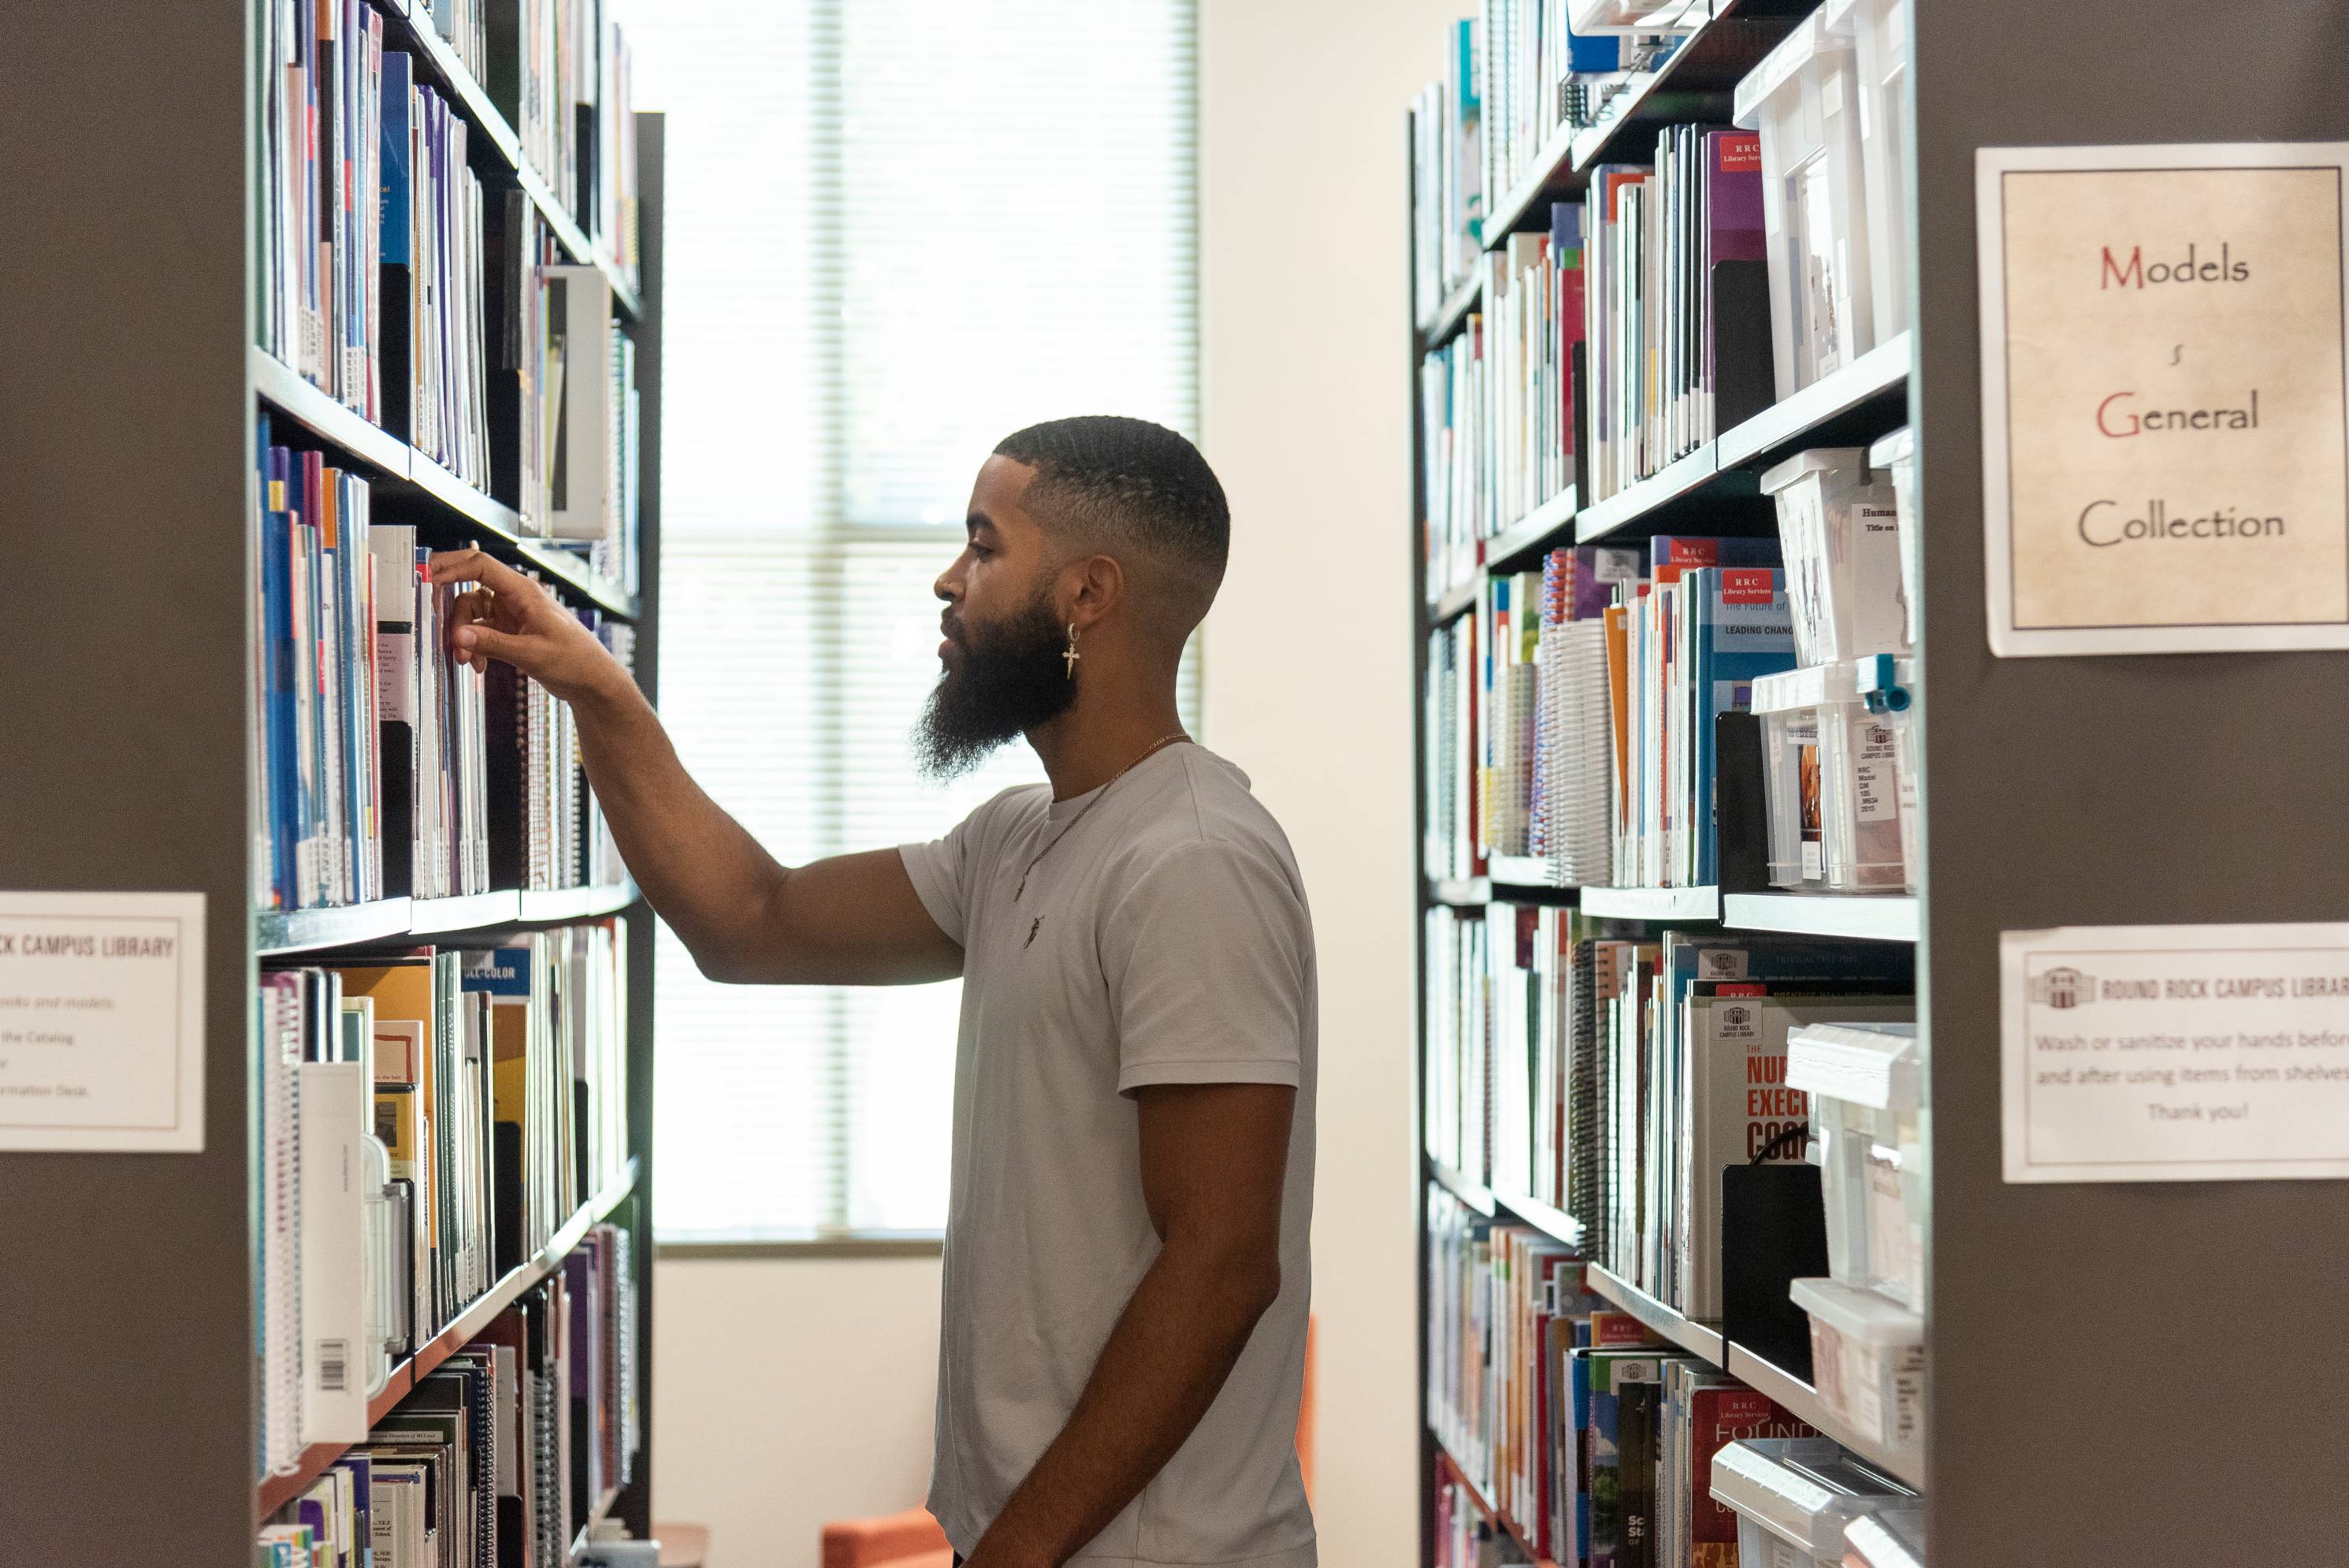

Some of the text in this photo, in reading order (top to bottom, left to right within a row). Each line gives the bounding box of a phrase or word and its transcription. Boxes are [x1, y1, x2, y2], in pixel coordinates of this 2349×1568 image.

[2101, 243, 2250, 290] Models
[2096, 391, 2258, 438] General
[1862, 508, 1897, 517] Human
[2078, 500, 2284, 548] Collection
[22, 935, 94, 957] CAMPUS
[102, 937, 173, 957] LIBRARY
[2102, 979, 2159, 1000] ROUND
[2165, 979, 2208, 998] ROCK
[2215, 978, 2284, 998] CAMPUS
[2035, 1035, 2087, 1050] Wash
[2092, 1038, 2111, 1050] or
[2117, 1034, 2186, 1049] sanitize
[2192, 1035, 2232, 1050] your
[2239, 1032, 2292, 1046] hands
[2036, 1068, 2071, 1085] and
[2077, 1066, 2120, 1085] after
[2127, 1068, 2174, 1087] using
[2180, 1067, 2230, 1082] items
[2236, 1064, 2277, 1080] from
[2148, 1102, 2249, 1122] Thank you!
